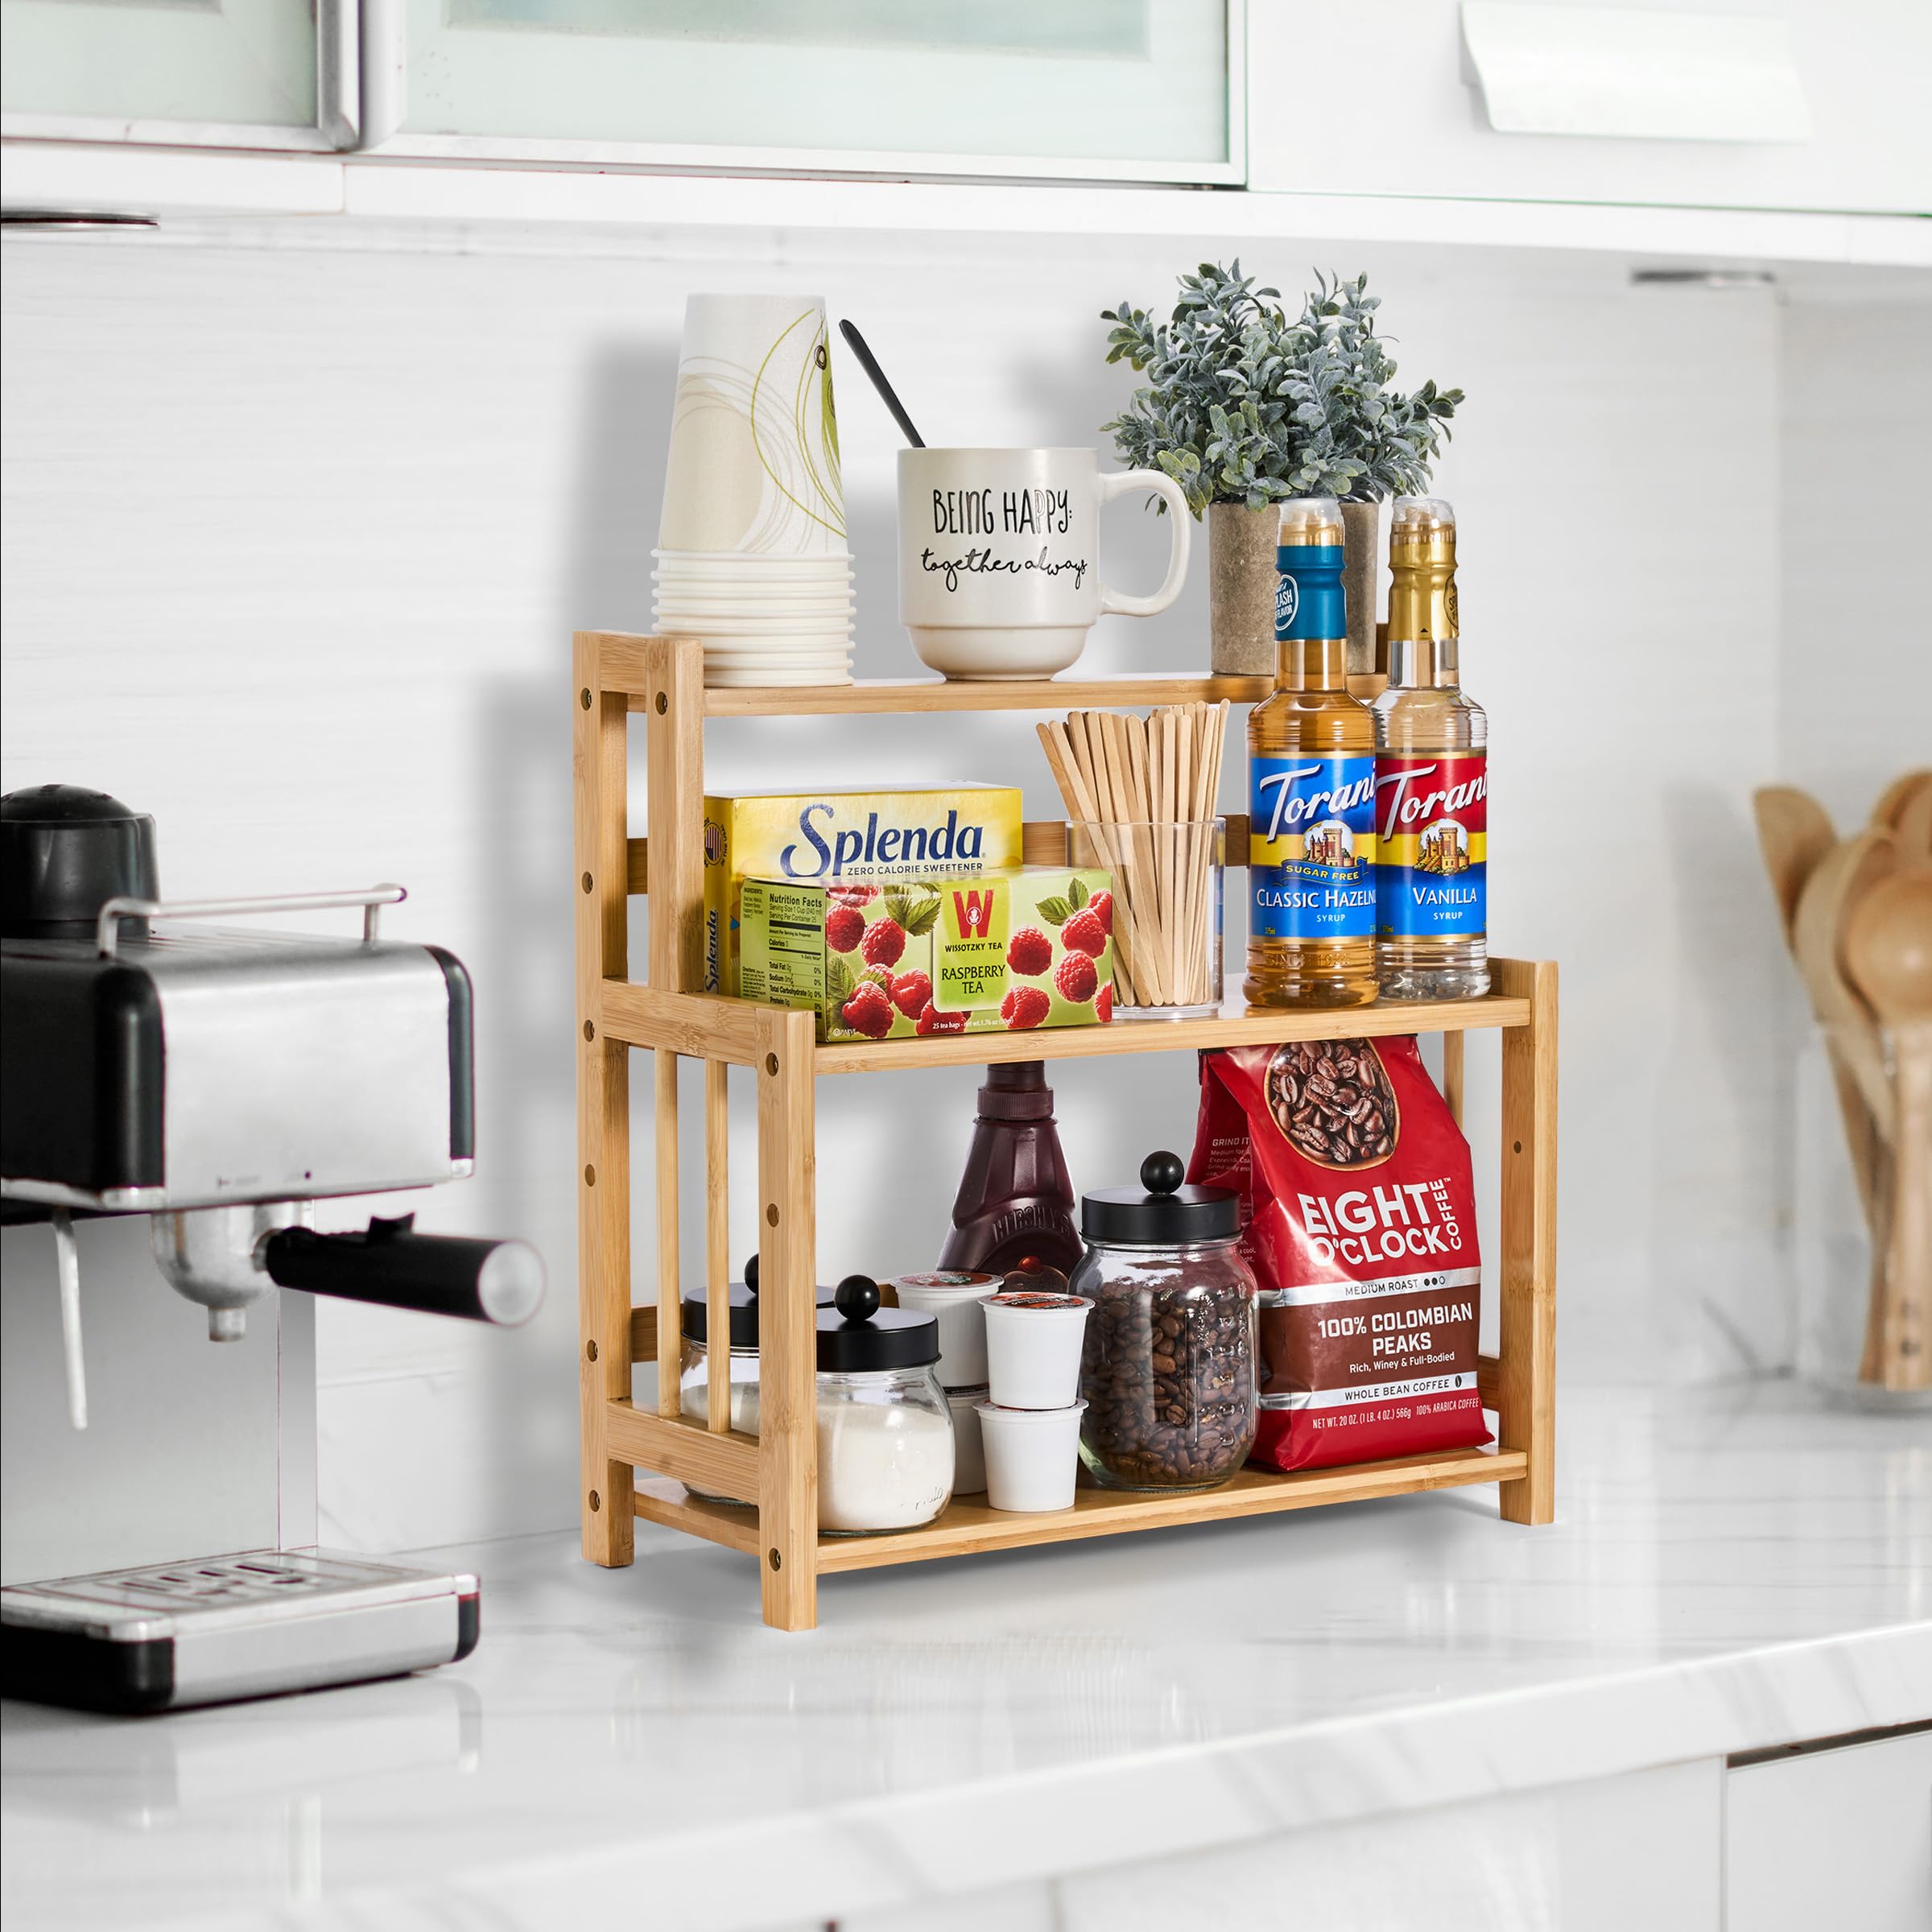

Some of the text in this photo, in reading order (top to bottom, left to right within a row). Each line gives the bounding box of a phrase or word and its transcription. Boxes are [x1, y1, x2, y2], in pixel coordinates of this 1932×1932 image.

[933, 489, 994, 535] BEING
[921, 546, 1088, 592] together always
[1275, 589, 1293, 609] LASH
[1260, 761, 1376, 844] Torani
[848, 862, 983, 876] ZERO CALORIE SWEETENER
[1286, 865, 1360, 881] SUGAR FREE
[770, 894, 823, 908] Nutrition Facts
[1257, 888, 1319, 908] CLASSIC
[1412, 887, 1477, 906] VANILLA
[953, 890, 993, 939] W
[1316, 914, 1345, 923] SYRUP
[1433, 911, 1463, 921] SYRUP
[945, 942, 1003, 952] WISSOTZKY TEA
[814, 967, 822, 975] 0%
[942, 964, 1005, 980] RASPBERRY
[962, 981, 985, 994] TEA
[948, 1021, 960, 1030] bags
[1212, 1138, 1240, 1146] GRIND
[1297, 1183, 1431, 1236] EIGHT
[1429, 1179, 1462, 1250] COFFEE
[1307, 1224, 1450, 1266] O'CLOCK
[1345, 1278, 1418, 1296] MEDIUM ROAST
[1318, 1302, 1473, 1339] 100% COLOMBIAN
[1373, 1331, 1432, 1356] PEAKS
[1349, 1352, 1455, 1373] Rich, Winey & Full-Bodied
[1345, 1379, 1450, 1401] WHOLE BEAN COFFEE
[1416, 1397, 1480, 1416] 100% ARABICA COFFEE
[1313, 1408, 1412, 1430] NET WT. 20 OZ. (1 LB. 4 OZ.) 566g
